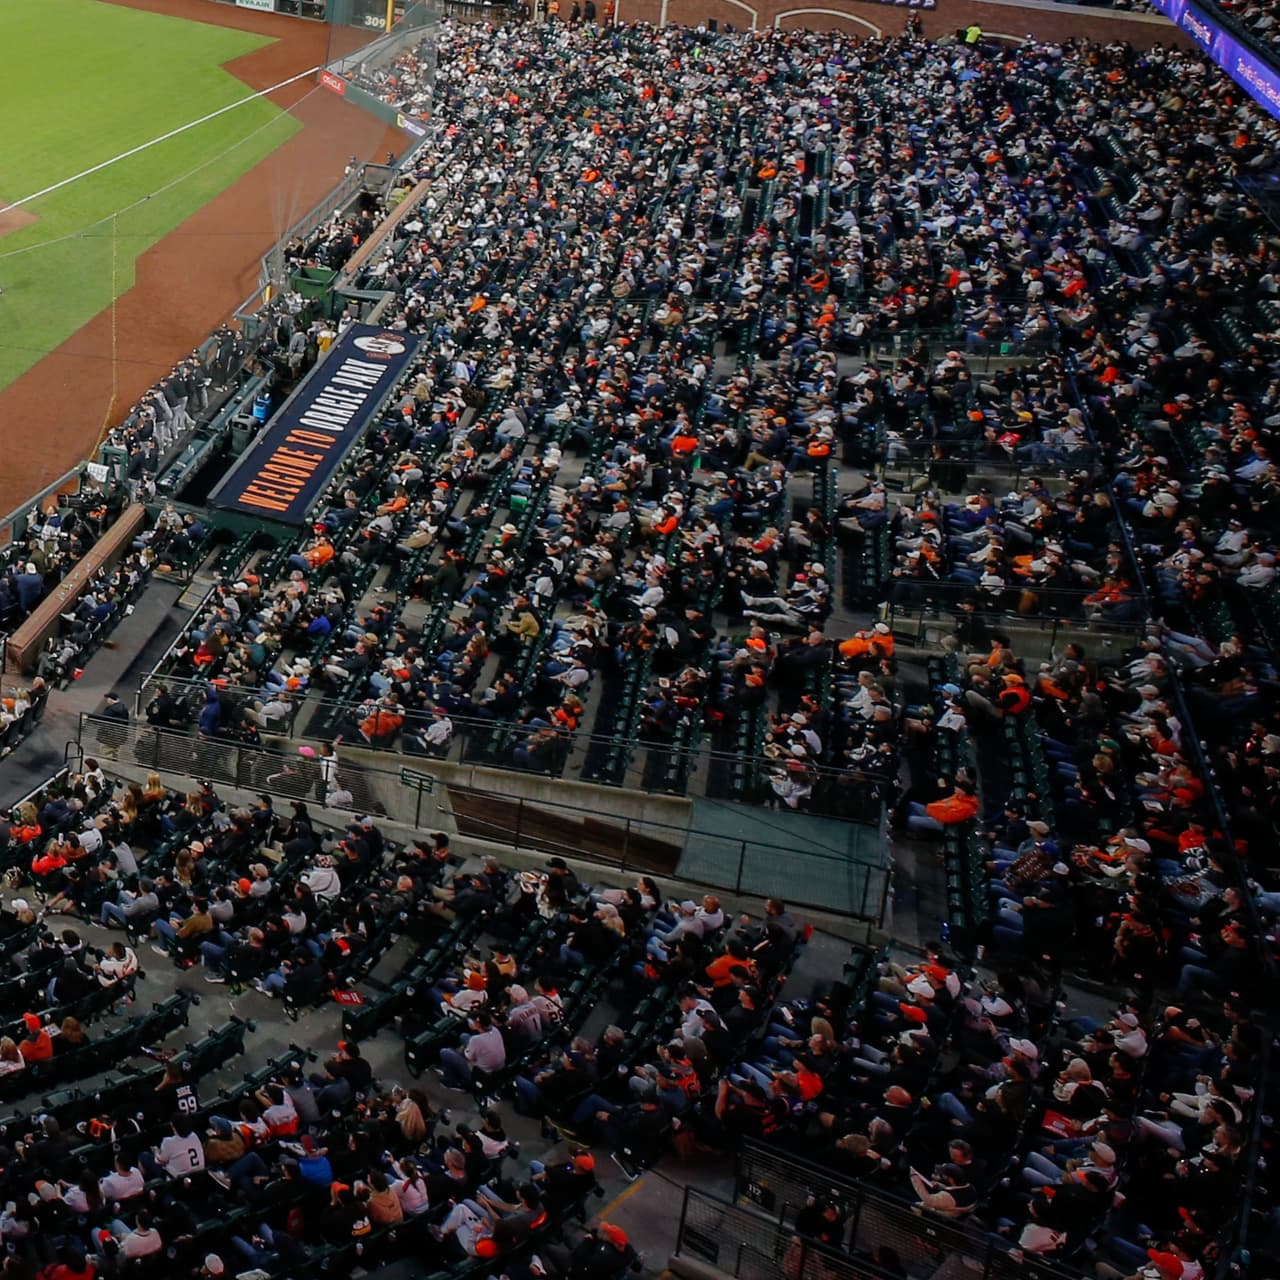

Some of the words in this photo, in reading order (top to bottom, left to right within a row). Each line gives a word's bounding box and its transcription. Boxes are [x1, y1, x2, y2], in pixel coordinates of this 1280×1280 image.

[239, 0, 254, 7] EVA
[364, 15, 386, 28] 309
[331, 357, 389, 390] PARK
[299, 385, 368, 432] ORACLE
[284, 428, 337, 449] TO
[238, 445, 325, 512] WELCOME
[178, 1096, 198, 1114] 99
[187, 1148, 200, 1167] 2
